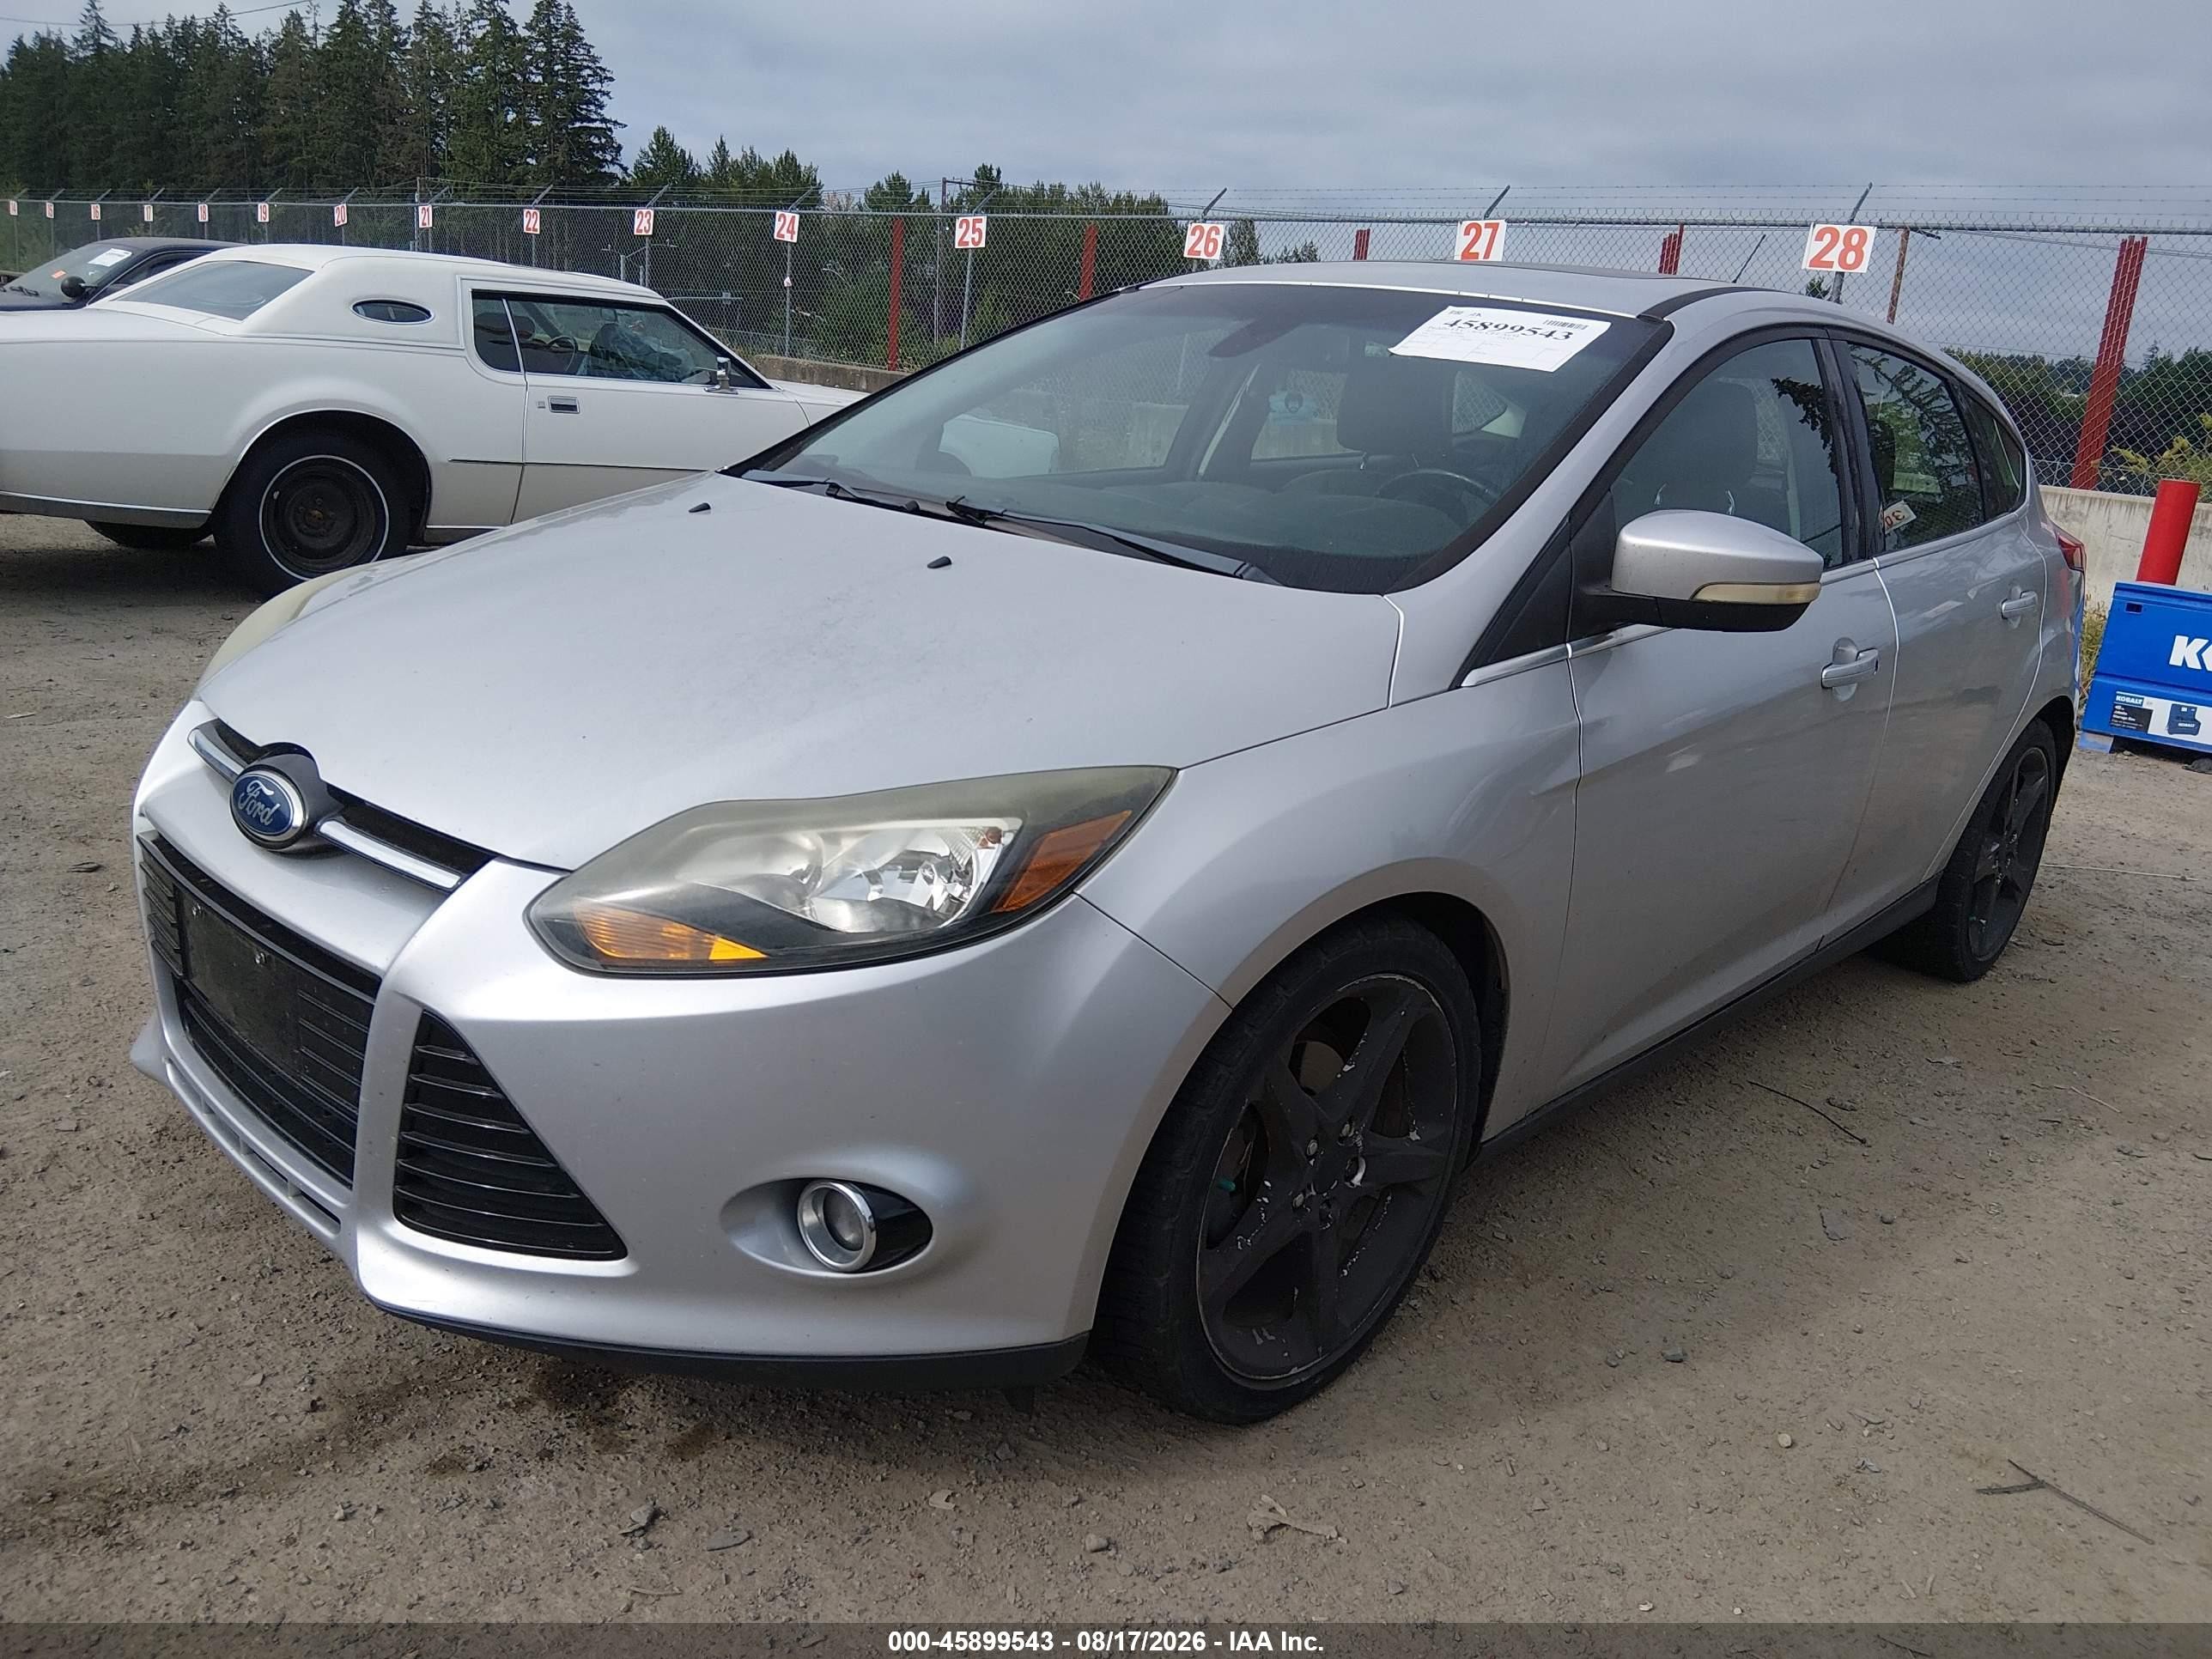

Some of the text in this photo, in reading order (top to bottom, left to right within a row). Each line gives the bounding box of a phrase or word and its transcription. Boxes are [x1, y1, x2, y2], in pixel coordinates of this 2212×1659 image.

[145, 205, 152, 220] 17
[199, 204, 207, 221] 18
[259, 204, 268, 221] 19
[336, 205, 347, 225] 20
[421, 206, 430, 227] 21
[525, 210, 539, 233] 22
[635, 210, 653, 234] 23
[776, 213, 797, 240] 24
[958, 217, 984, 246] 25
[1187, 224, 1220, 258] 26
[1461, 222, 1500, 260] 27
[1808, 226, 1869, 270] 28
[1443, 319, 1574, 341] 45899543
[238, 780, 281, 825] Ford
